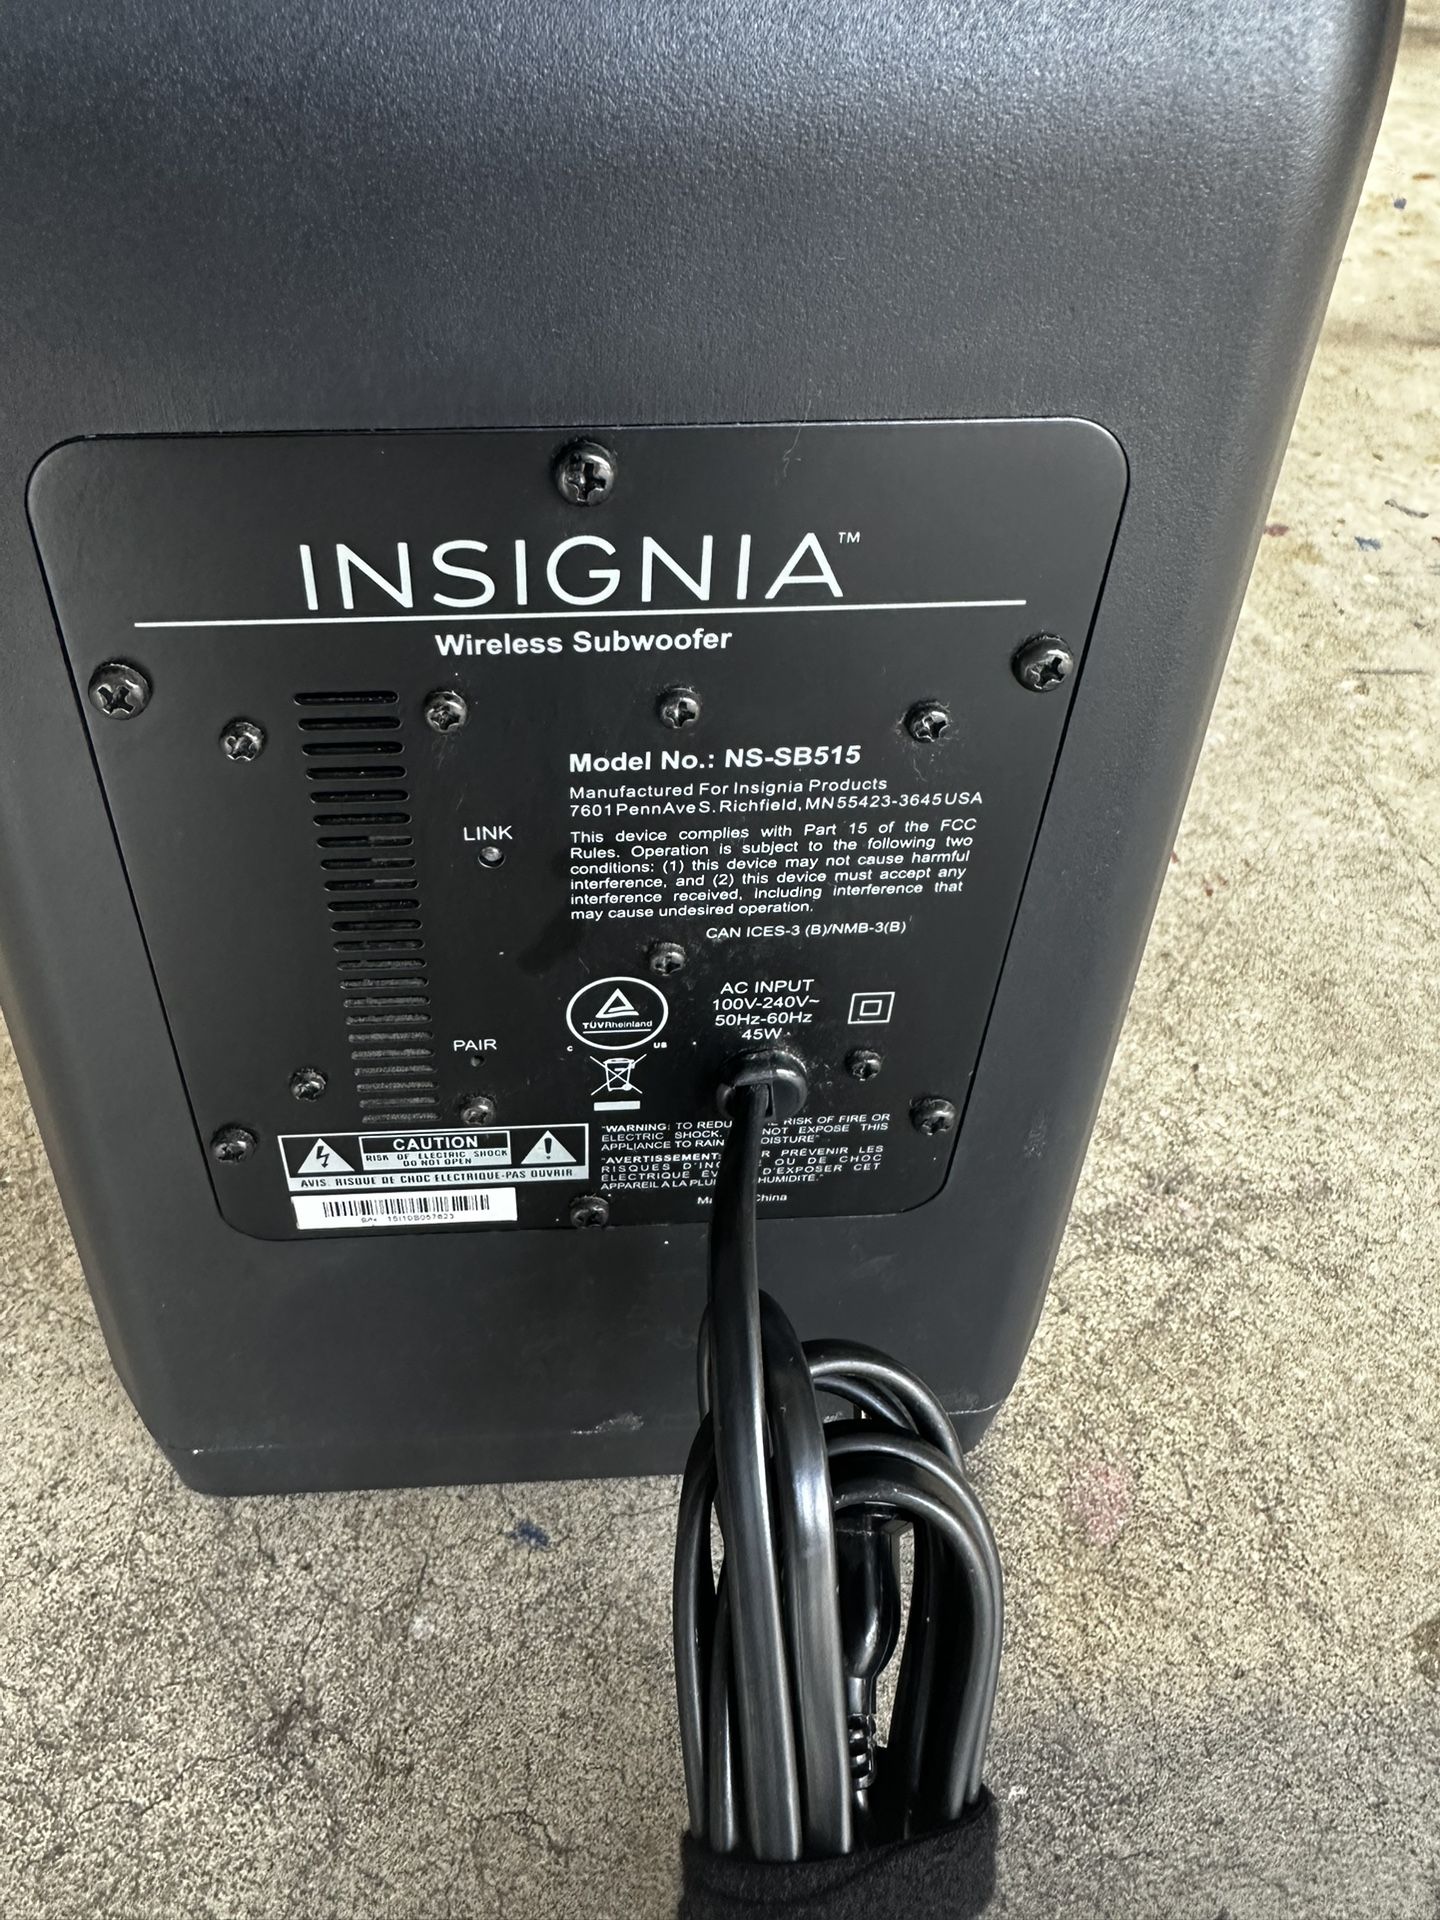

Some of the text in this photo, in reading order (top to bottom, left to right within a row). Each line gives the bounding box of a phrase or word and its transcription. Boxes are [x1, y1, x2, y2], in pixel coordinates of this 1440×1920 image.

[300, 532, 846, 610] INSIGNIA
[435, 628, 732, 655] Wireless Subwoofer
[570, 745, 861, 772] Model No.: NS-SB515
[570, 779, 887, 799] Manufactured For Insignia Products
[571, 804, 610, 816] 7601
[699, 801, 715, 813] S.
[720, 799, 801, 812] Richfield,
[945, 792, 982, 805] USA
[464, 826, 512, 840] LINK
[571, 818, 976, 843] This device complies with Part 15 of the FCC
[571, 836, 973, 859] Rules. Operation is subject to the following two
[571, 850, 970, 874] conditions: (1) this device may not cause harmful
[571, 868, 966, 889] interference, and (2) this device must accept any
[571, 882, 962, 904] interference received, including interference that
[571, 903, 813, 921] may cause undesired operation.
[706, 922, 906, 938] CAN ICES-3 (B)/NMB-3(B)
[721, 979, 814, 994] AC INPUT
[713, 996, 819, 1010] 100V-240V~
[716, 1012, 812, 1026] 50Hz-60Hz
[742, 1028, 782, 1040] 45W
[454, 1039, 496, 1051] PAIR
[602, 1133, 663, 1142] ELECTRIC
[799, 1125, 849, 1133] EXPOSE
[861, 1123, 888, 1131] THIS
[393, 1136, 477, 1150] CAUTION
[601, 1141, 670, 1151] APPLIANCE
[336, 1177, 375, 1185] RISQUE
[401, 1175, 430, 1183] CHOC
[531, 1169, 572, 1177] OUVRIR
[602, 1164, 669, 1173] RISQUES
[763, 1165, 842, 1174] D'EXPOSER
